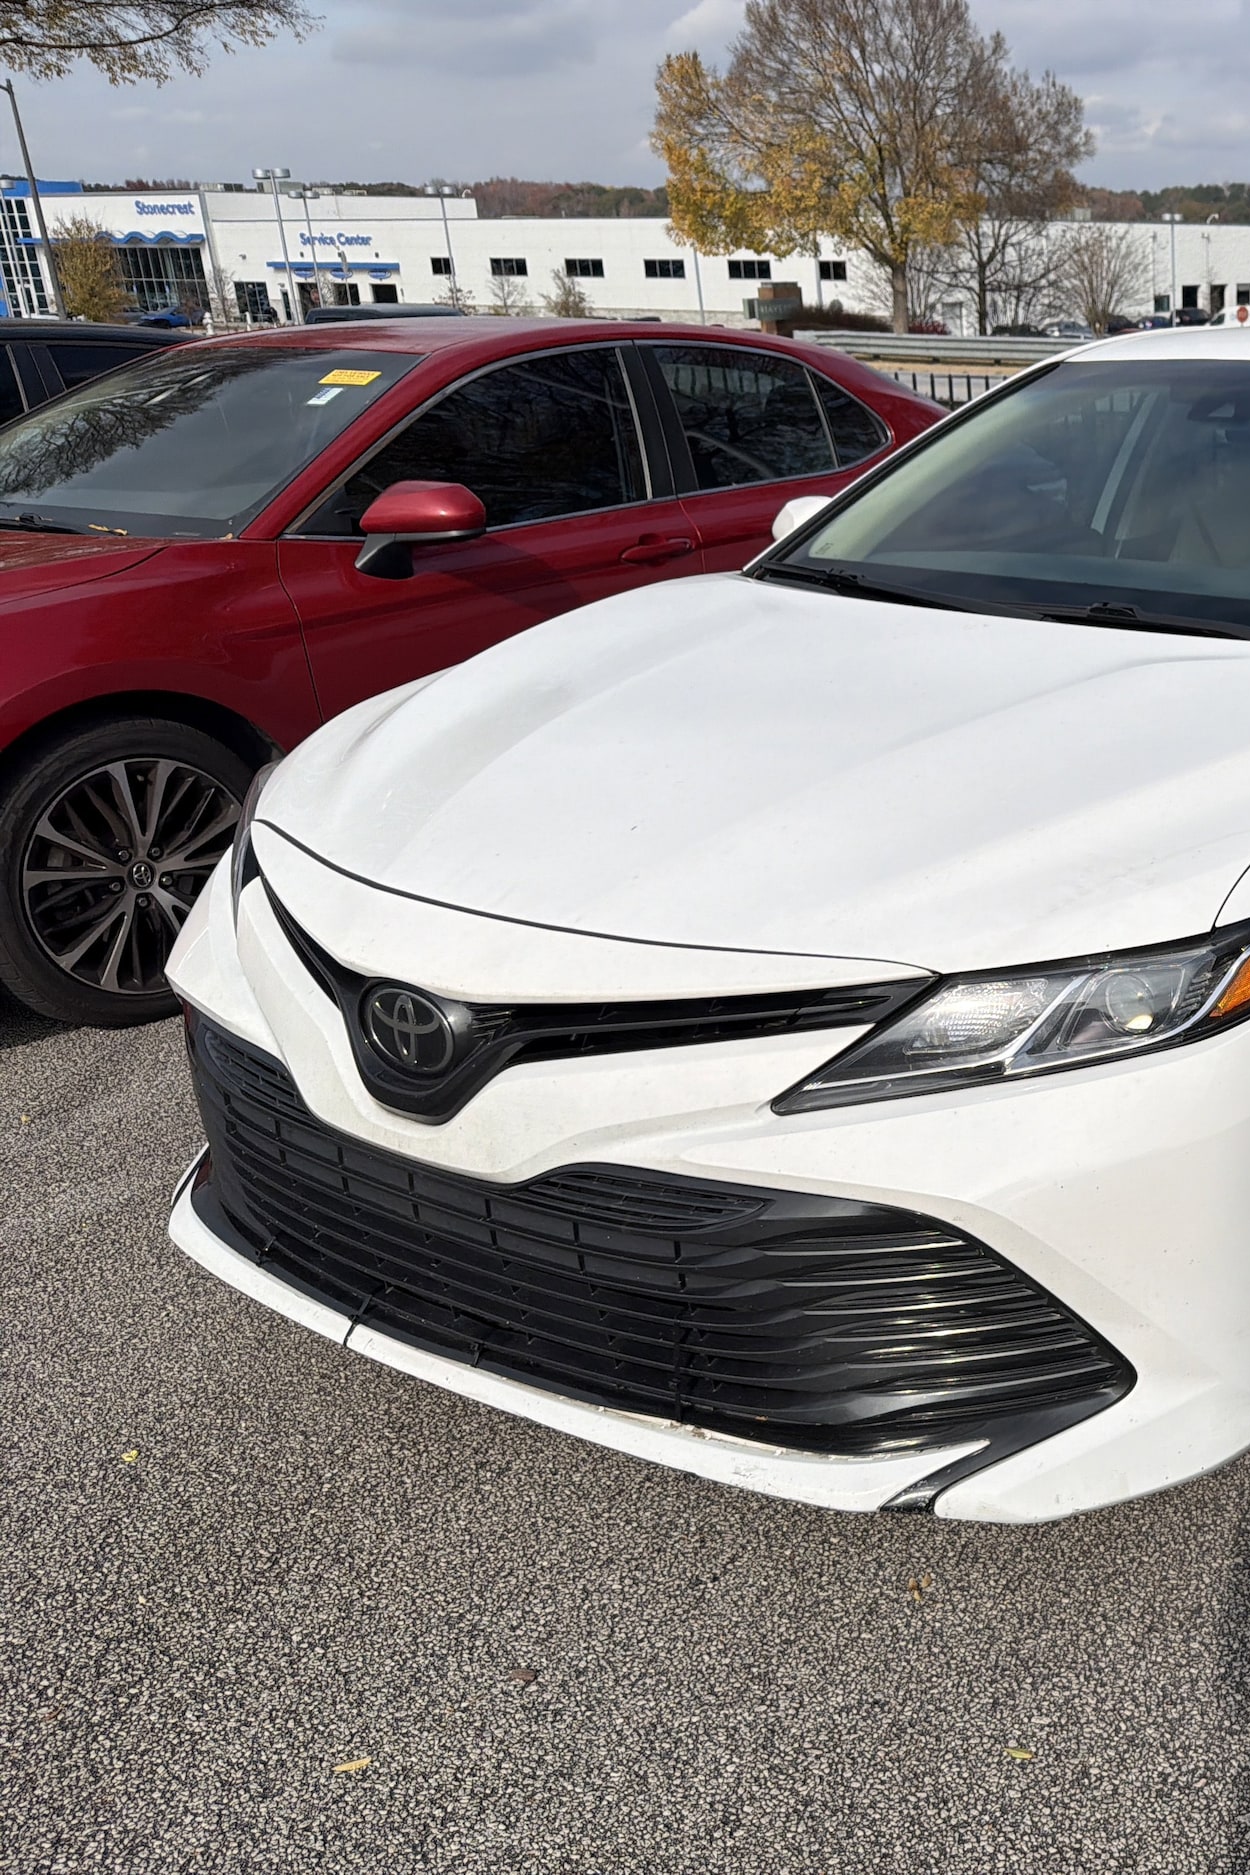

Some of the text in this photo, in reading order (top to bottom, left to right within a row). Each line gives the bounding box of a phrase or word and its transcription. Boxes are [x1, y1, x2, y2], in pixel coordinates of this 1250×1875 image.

[134, 200, 196, 215] Stonecrest
[299, 232, 373, 246] Service Center
